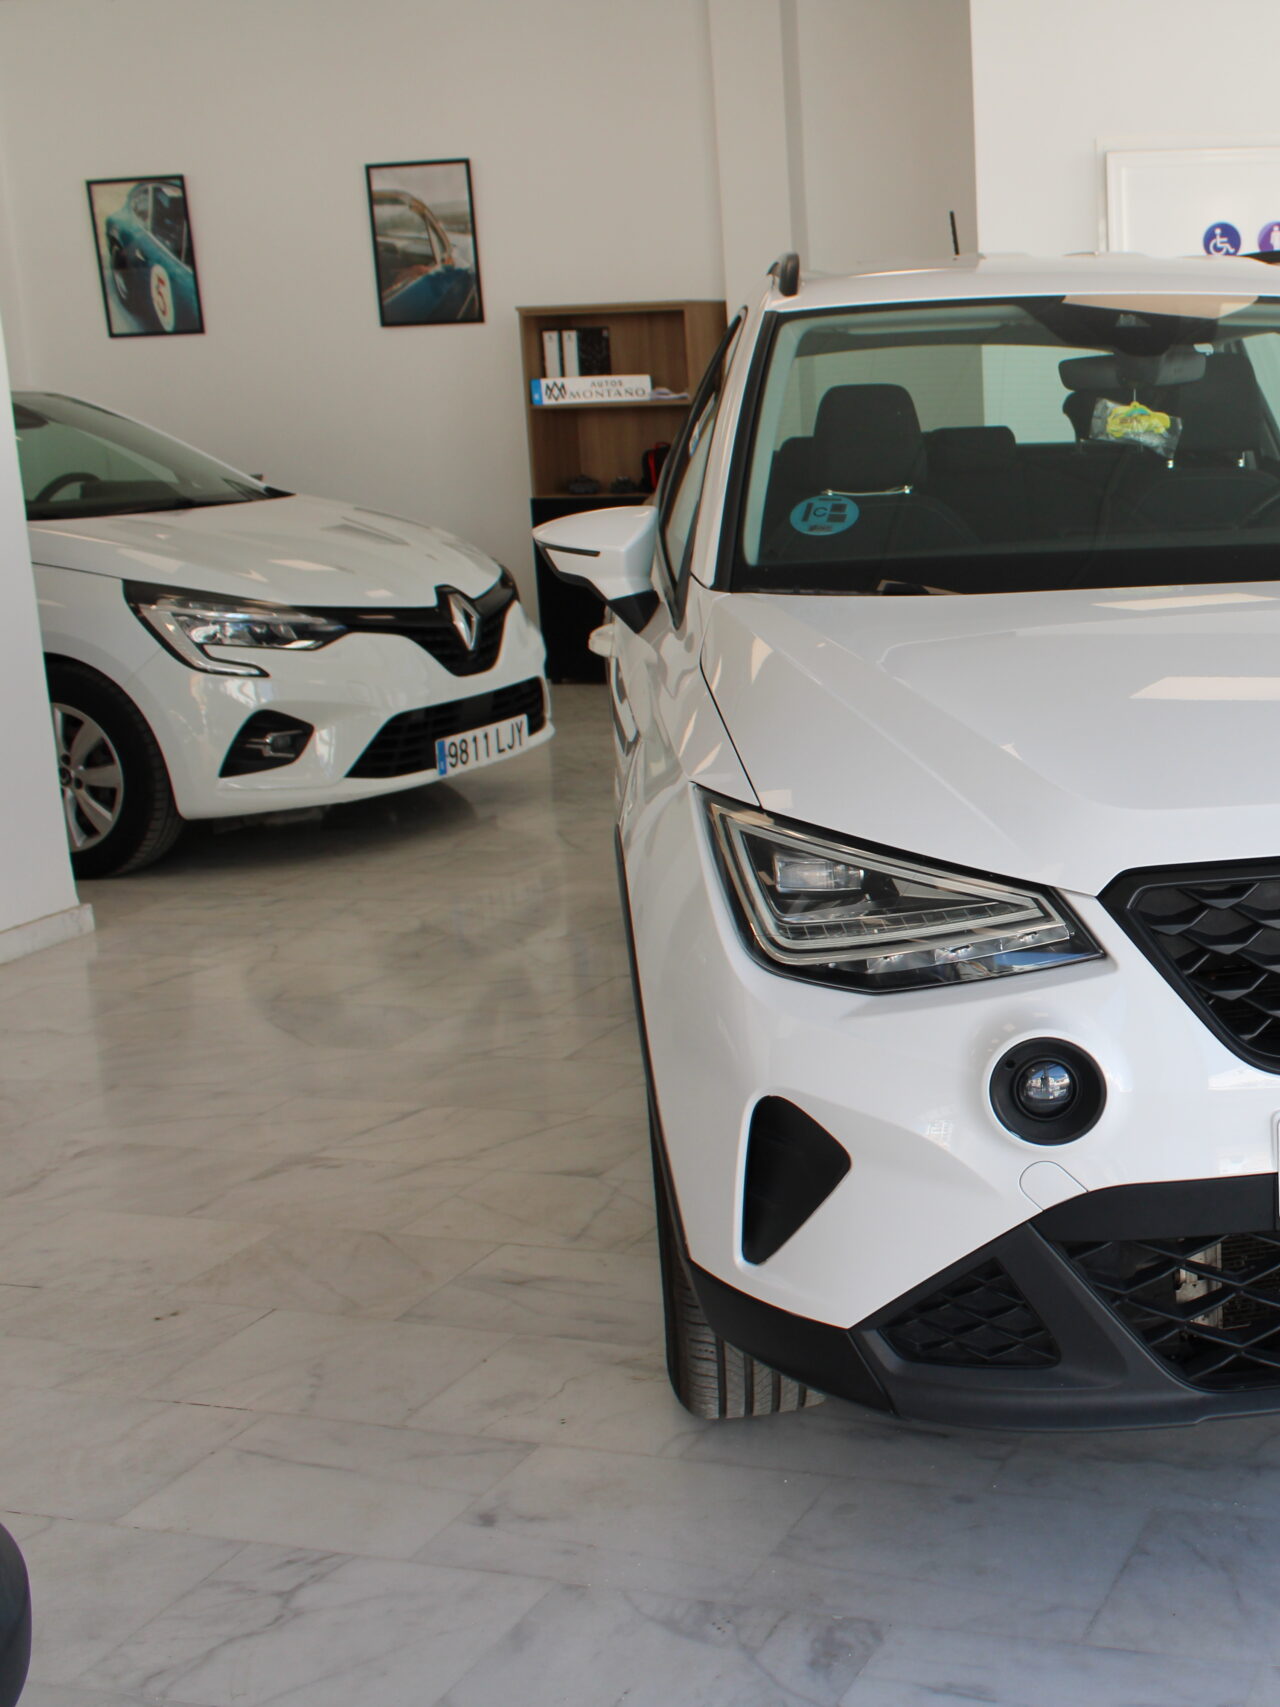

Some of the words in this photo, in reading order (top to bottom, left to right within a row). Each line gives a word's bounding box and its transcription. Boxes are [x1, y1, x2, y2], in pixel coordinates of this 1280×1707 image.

[591, 379, 623, 388] AUTOS
[448, 732, 490, 768] 9811
[497, 720, 524, 753] LJY
